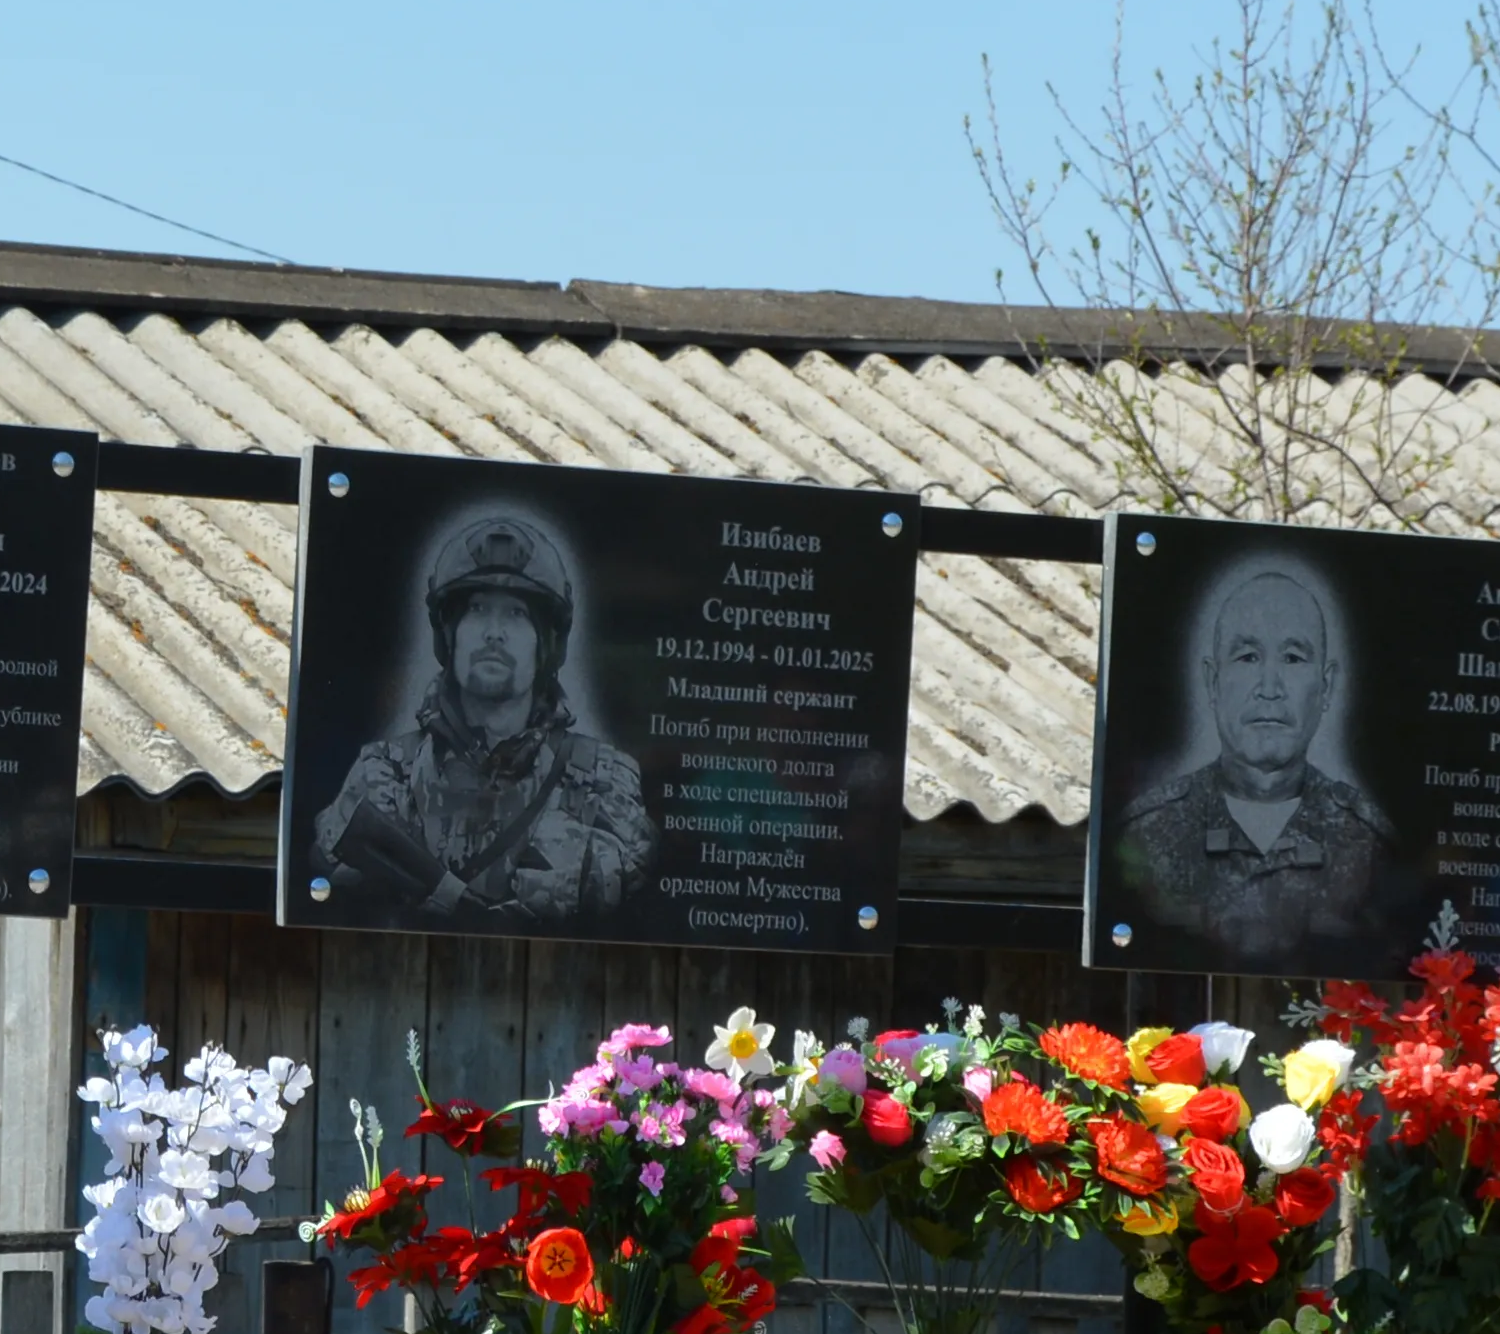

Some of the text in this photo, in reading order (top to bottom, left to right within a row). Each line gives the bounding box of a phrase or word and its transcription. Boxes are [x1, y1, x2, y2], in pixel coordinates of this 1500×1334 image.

[720, 521, 821, 553] Изибаев
[723, 561, 815, 595] Андрей
[701, 597, 830, 631] Сергеевич
[656, 636, 755, 663] 19.12.1994
[773, 644, 873, 672] 01.01.2025
[667, 675, 857, 711] Младший сержант
[649, 713, 869, 748] Погиб при исполнении
[680, 752, 835, 777] воинского долга
[1424, 763, 1480, 788] Погиб
[663, 782, 848, 809] в ходе специальной
[664, 813, 843, 842] военной операции.
[1436, 830, 1447, 845] в
[1451, 830, 1491, 848] ходе
[700, 841, 805, 870] Награждён
[659, 875, 841, 903] орденом Мужества
[687, 906, 809, 934] (посмертно).
